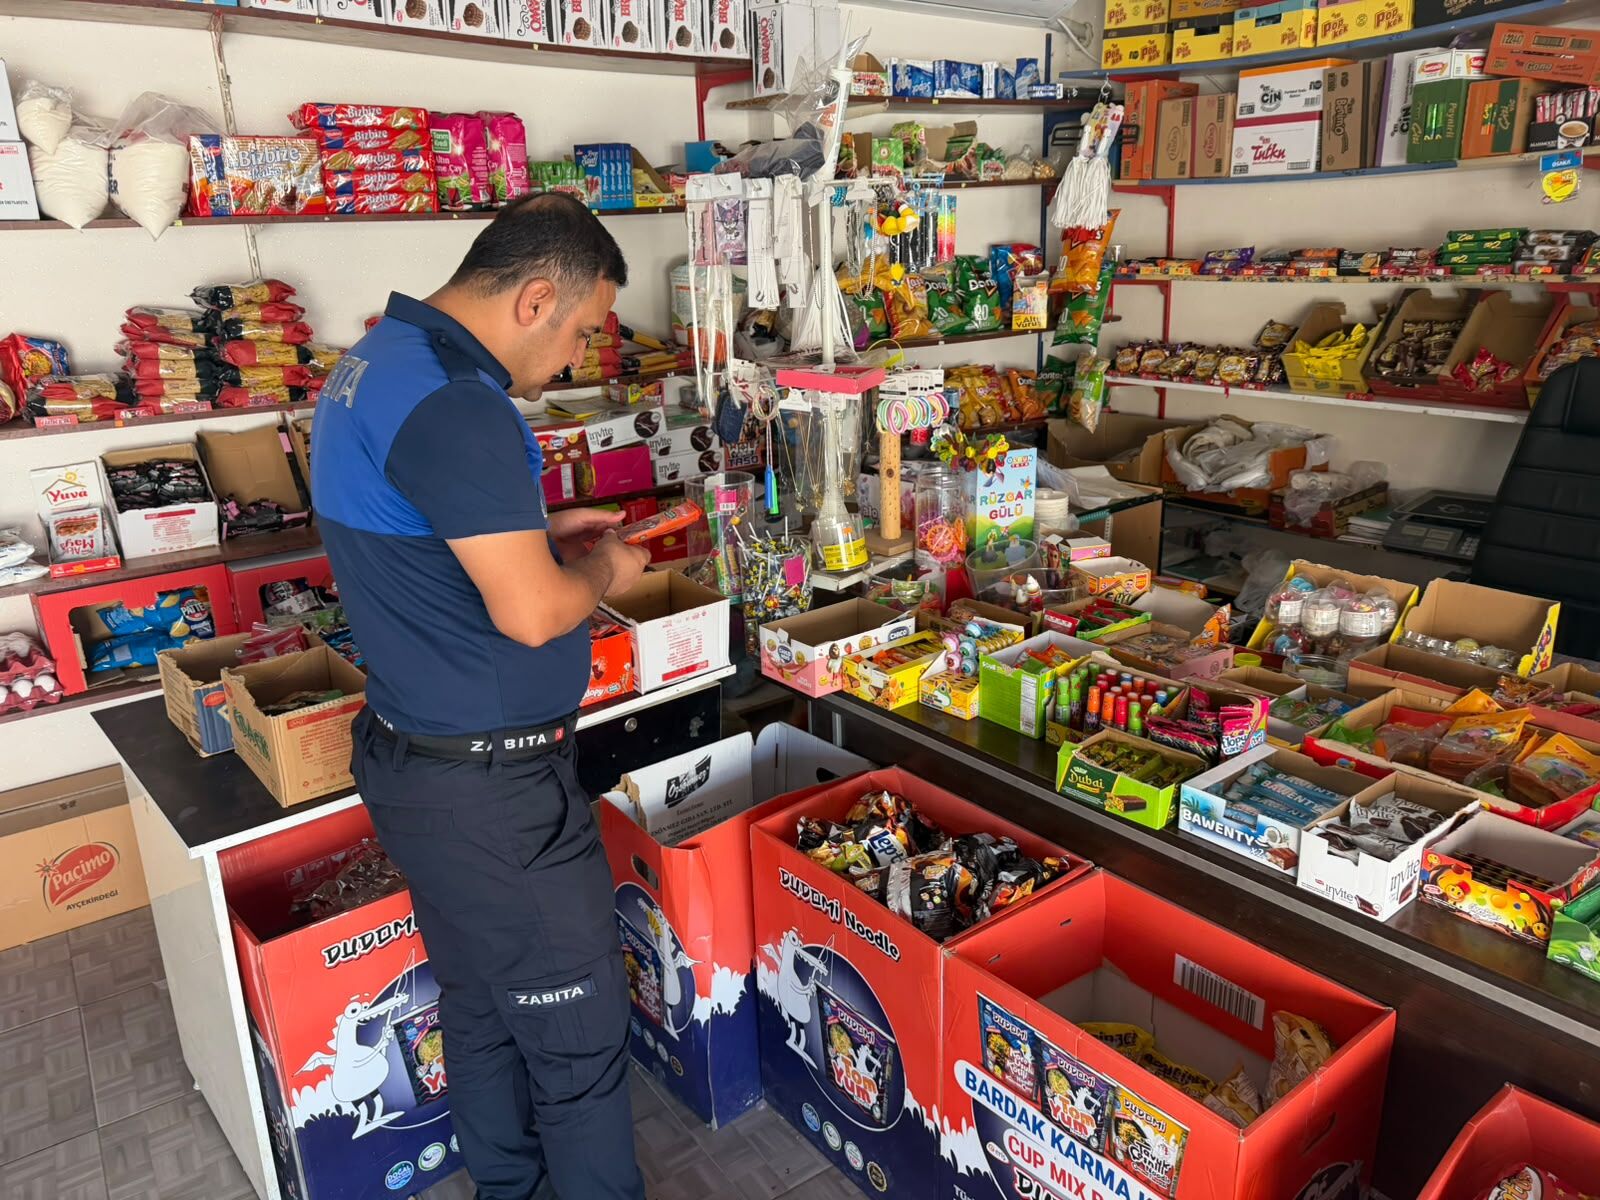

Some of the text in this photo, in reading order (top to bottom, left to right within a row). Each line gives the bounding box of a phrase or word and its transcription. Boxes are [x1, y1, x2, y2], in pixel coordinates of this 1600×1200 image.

[1251, 143, 1286, 161] Tutku
[50, 488, 88, 503] Yuva
[979, 489, 1033, 506] RÜZGAR
[989, 504, 1023, 520] GÜLÜ
[1068, 768, 1105, 791] Dubai
[1182, 809, 1255, 846] BAWENTY
[51, 850, 112, 891] Paçimo
[1325, 884, 1354, 901] invite
[845, 911, 900, 959] Noodle
[516, 985, 584, 1005] ZABITA
[1049, 1097, 1090, 1137] Yum
[1059, 1095, 1096, 1128] Tom
[965, 1068, 1045, 1142] BARDAK
[1051, 1128, 1131, 1199] KARMA
[1008, 1135, 1045, 1169] CUP
[1050, 1161, 1087, 1199] MIX
